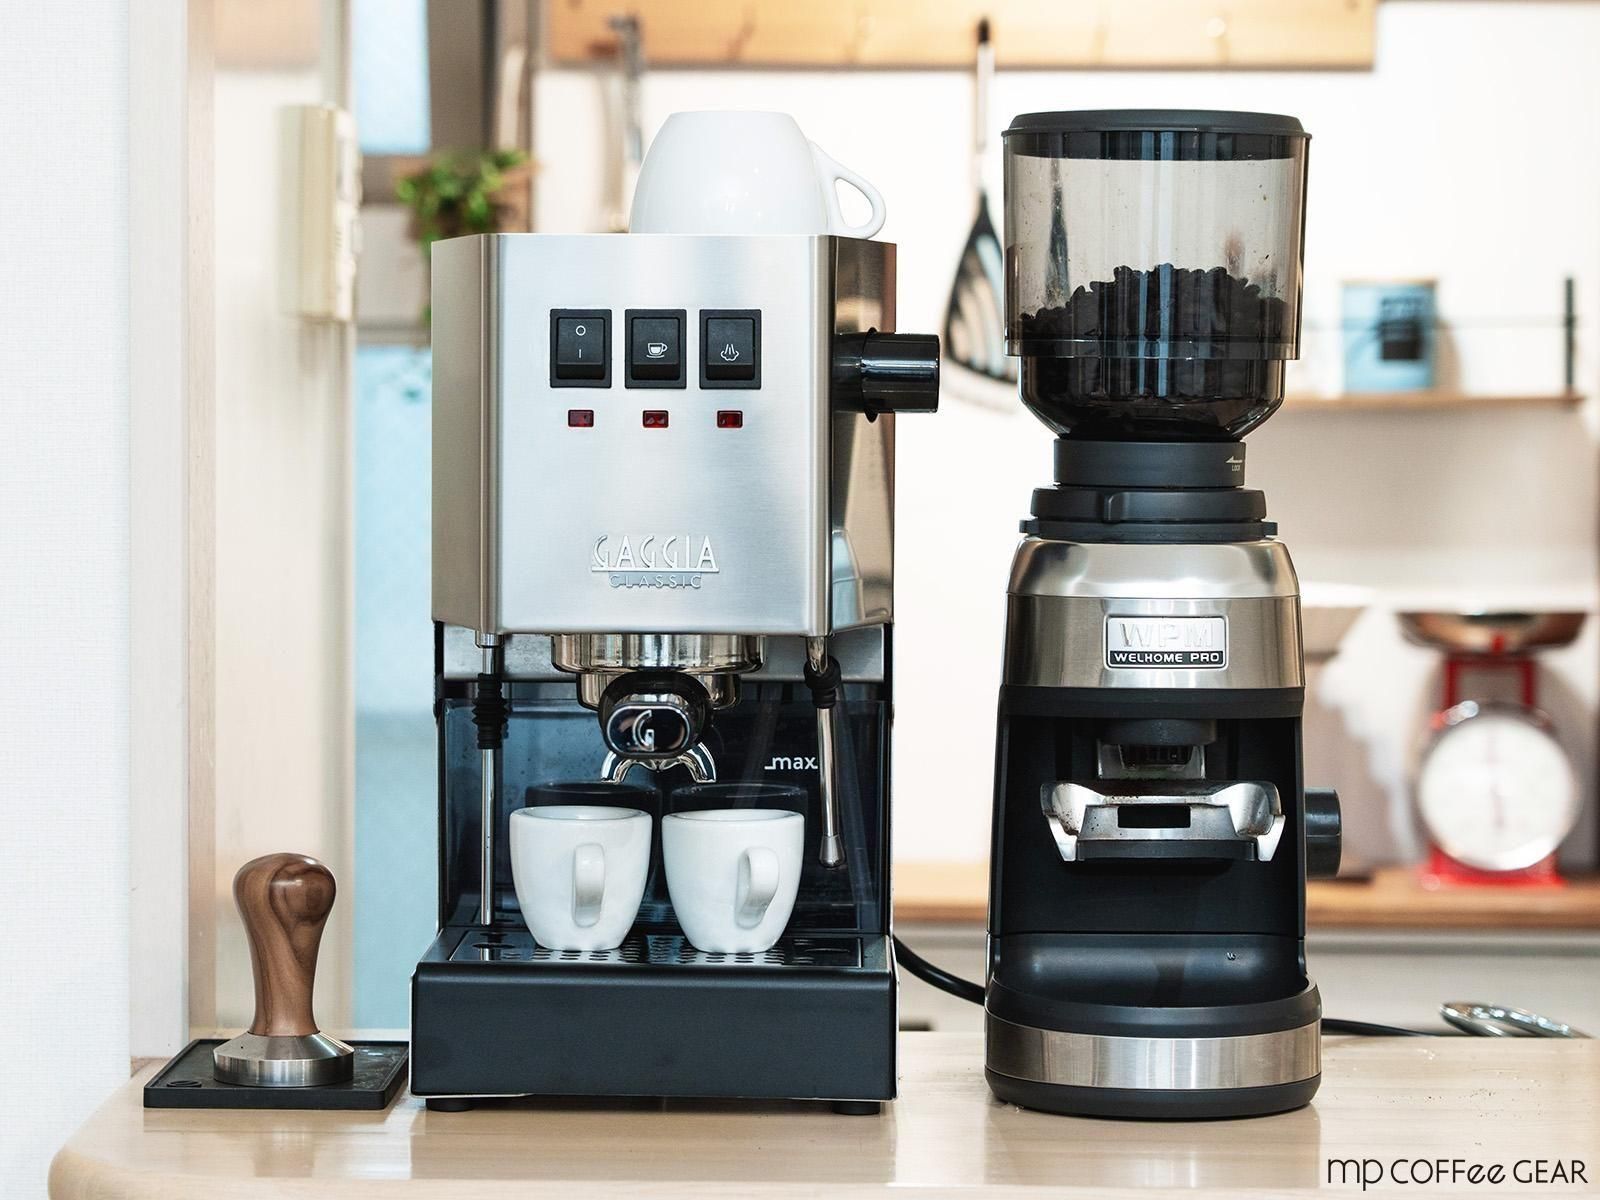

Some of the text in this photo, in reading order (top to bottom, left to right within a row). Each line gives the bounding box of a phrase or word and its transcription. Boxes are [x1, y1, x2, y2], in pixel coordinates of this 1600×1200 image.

[592, 535, 718, 568] GAGGIA
[608, 574, 702, 588] CLASSIC
[1119, 623, 1214, 648] WPM
[1114, 652, 1220, 663] WELHOME PRO
